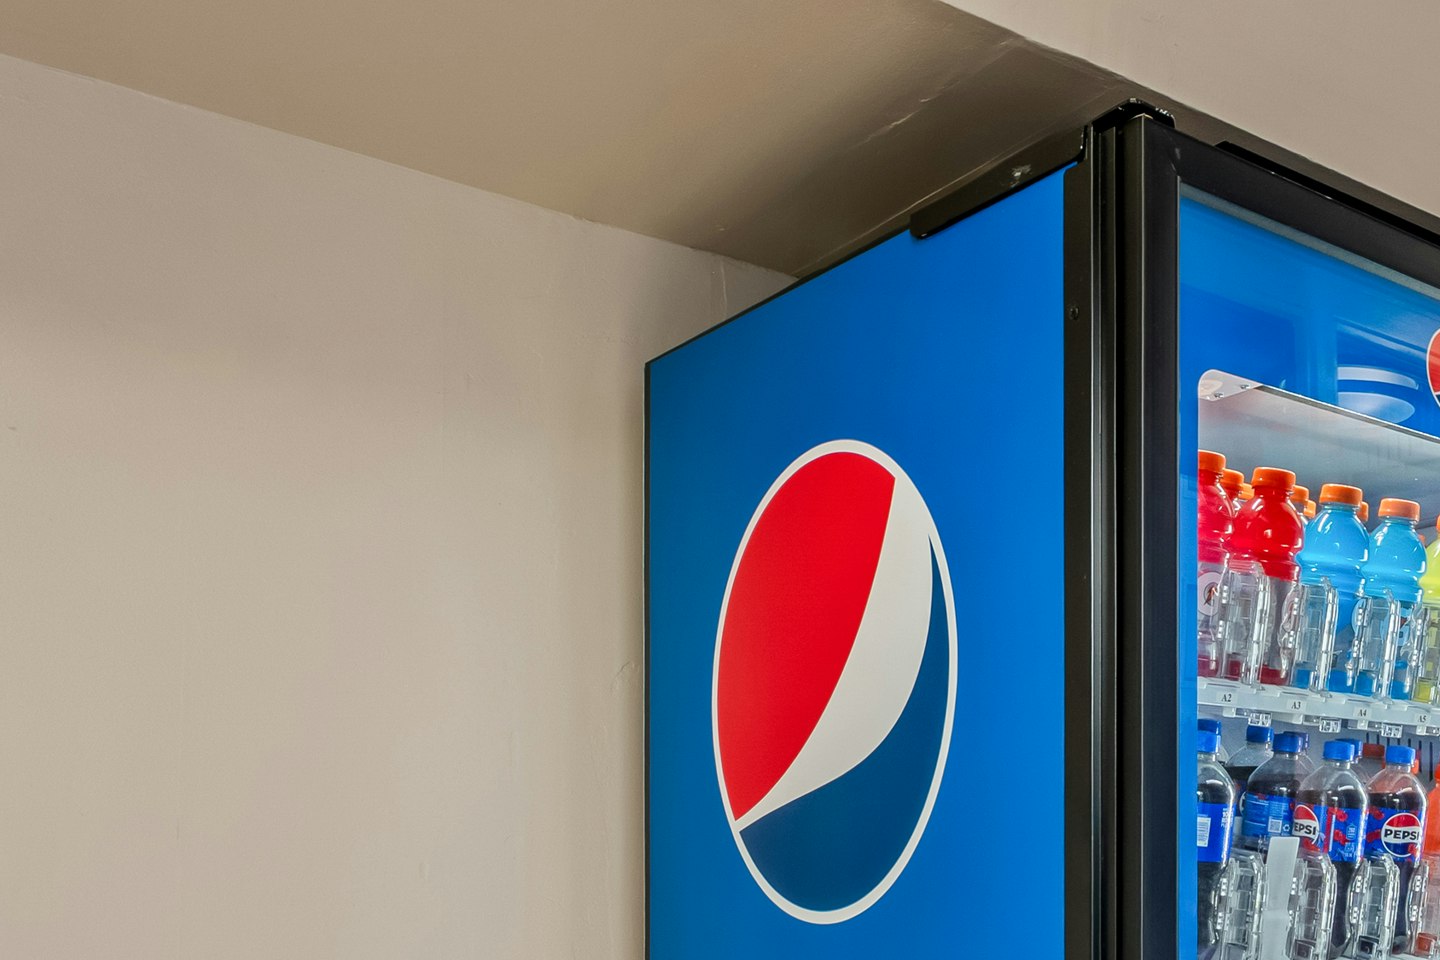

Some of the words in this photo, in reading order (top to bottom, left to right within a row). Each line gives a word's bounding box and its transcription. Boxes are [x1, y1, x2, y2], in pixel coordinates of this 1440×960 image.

[1221, 692, 1232, 702] A2
[1291, 700, 1301, 710] A3
[1357, 708, 1367, 717] A4
[1417, 714, 1427, 723] A5
[1293, 822, 1317, 836] EPSI
[1384, 828, 1420, 841] PEPSI
